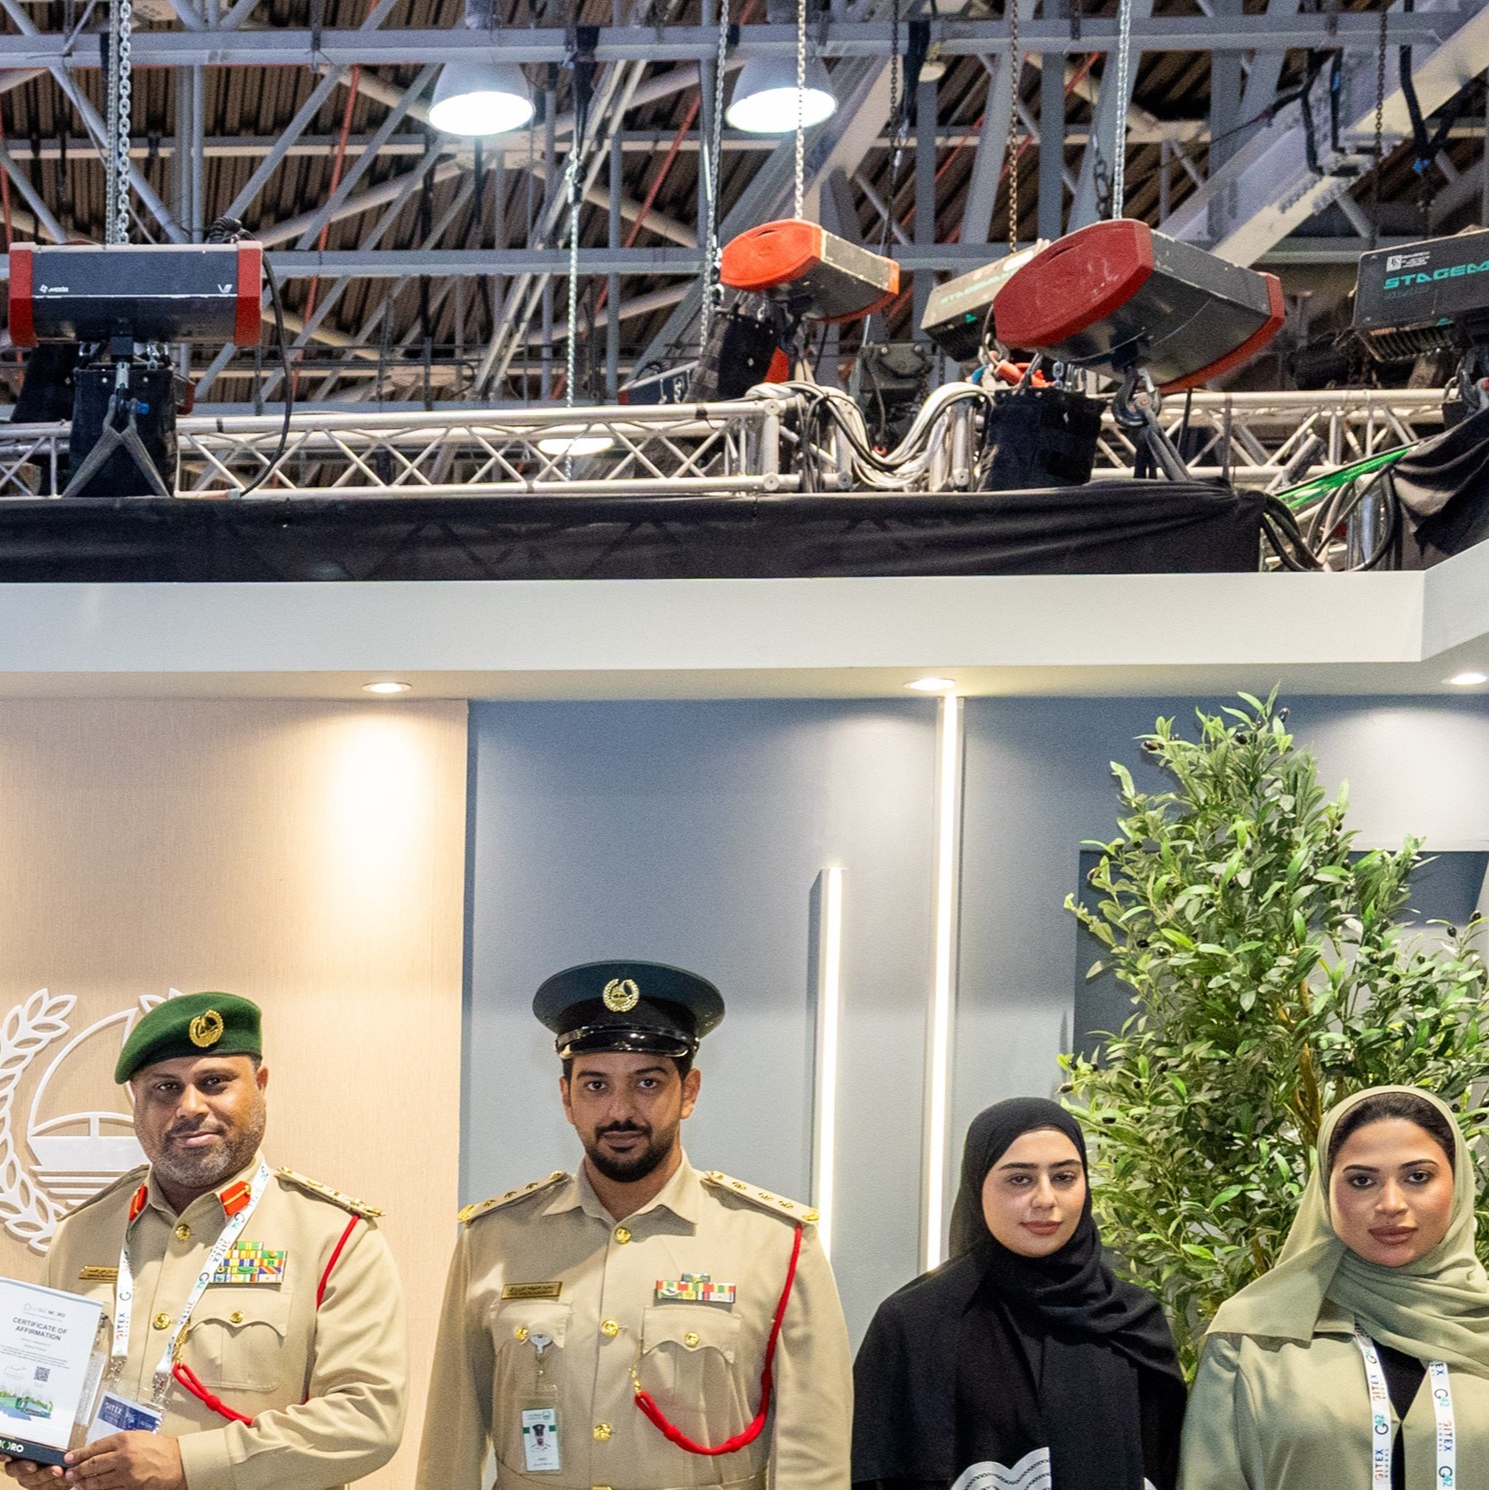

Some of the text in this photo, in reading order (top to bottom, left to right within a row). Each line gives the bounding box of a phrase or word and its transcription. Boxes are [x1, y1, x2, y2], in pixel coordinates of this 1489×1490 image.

[12, 1317, 56, 1332] CERTIFICATE
[15, 1325, 61, 1341] AFFIRMATION
[1374, 1448, 1384, 1481] GITEX
